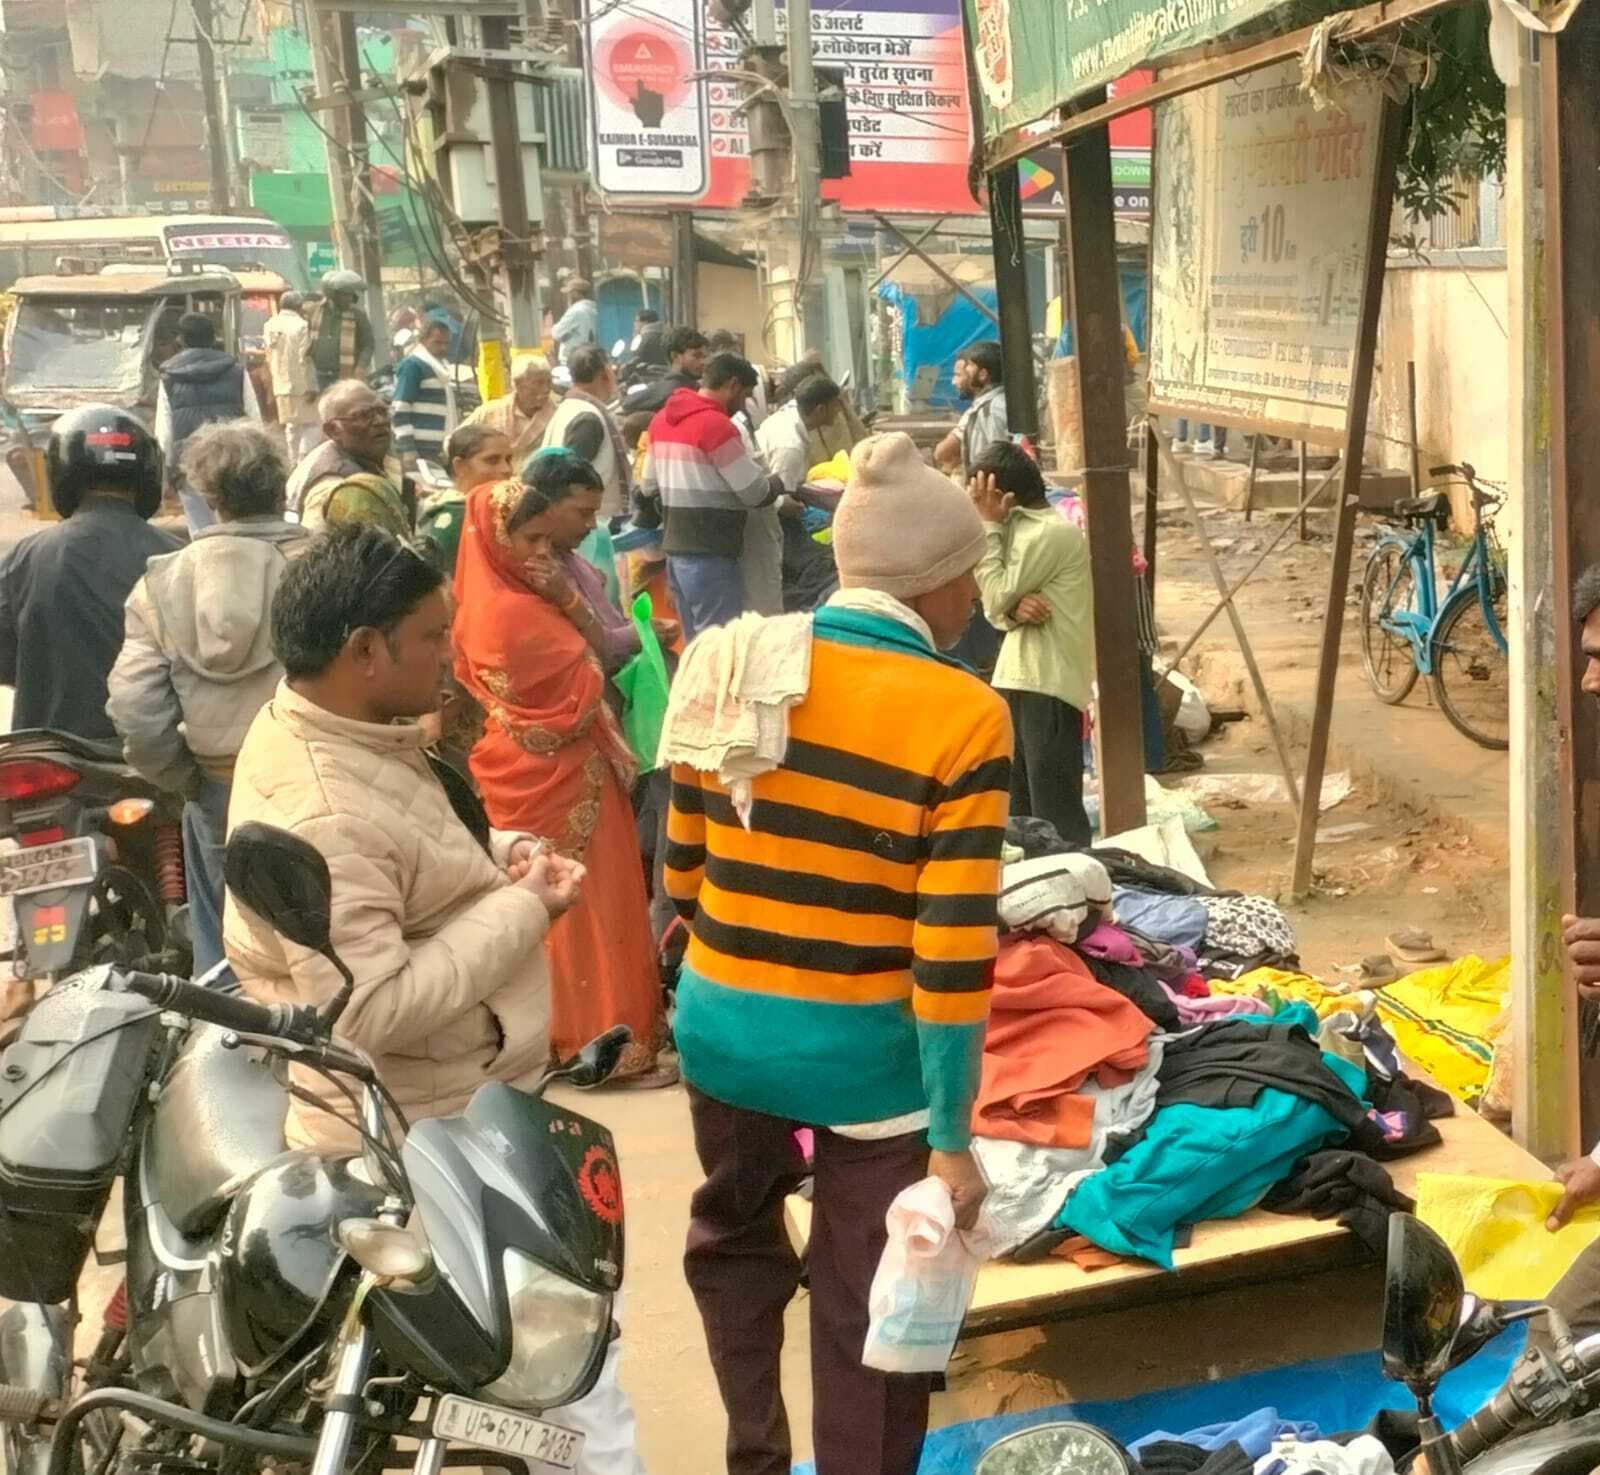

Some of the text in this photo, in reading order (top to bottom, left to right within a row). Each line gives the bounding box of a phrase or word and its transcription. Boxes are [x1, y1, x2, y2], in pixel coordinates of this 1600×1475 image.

[825, 14, 864, 31] अलर्ट
[885, 39, 913, 57] भेजें
[860, 63, 889, 84] तुरंत
[892, 67, 934, 86] सूचना
[599, 133, 699, 148] KAIMUR E-SURAKSHA
[859, 141, 882, 158] करें
[1128, 195, 1150, 207] on
[173, 235, 290, 248] NEERAJ
[1262, 203, 1286, 264] 10
